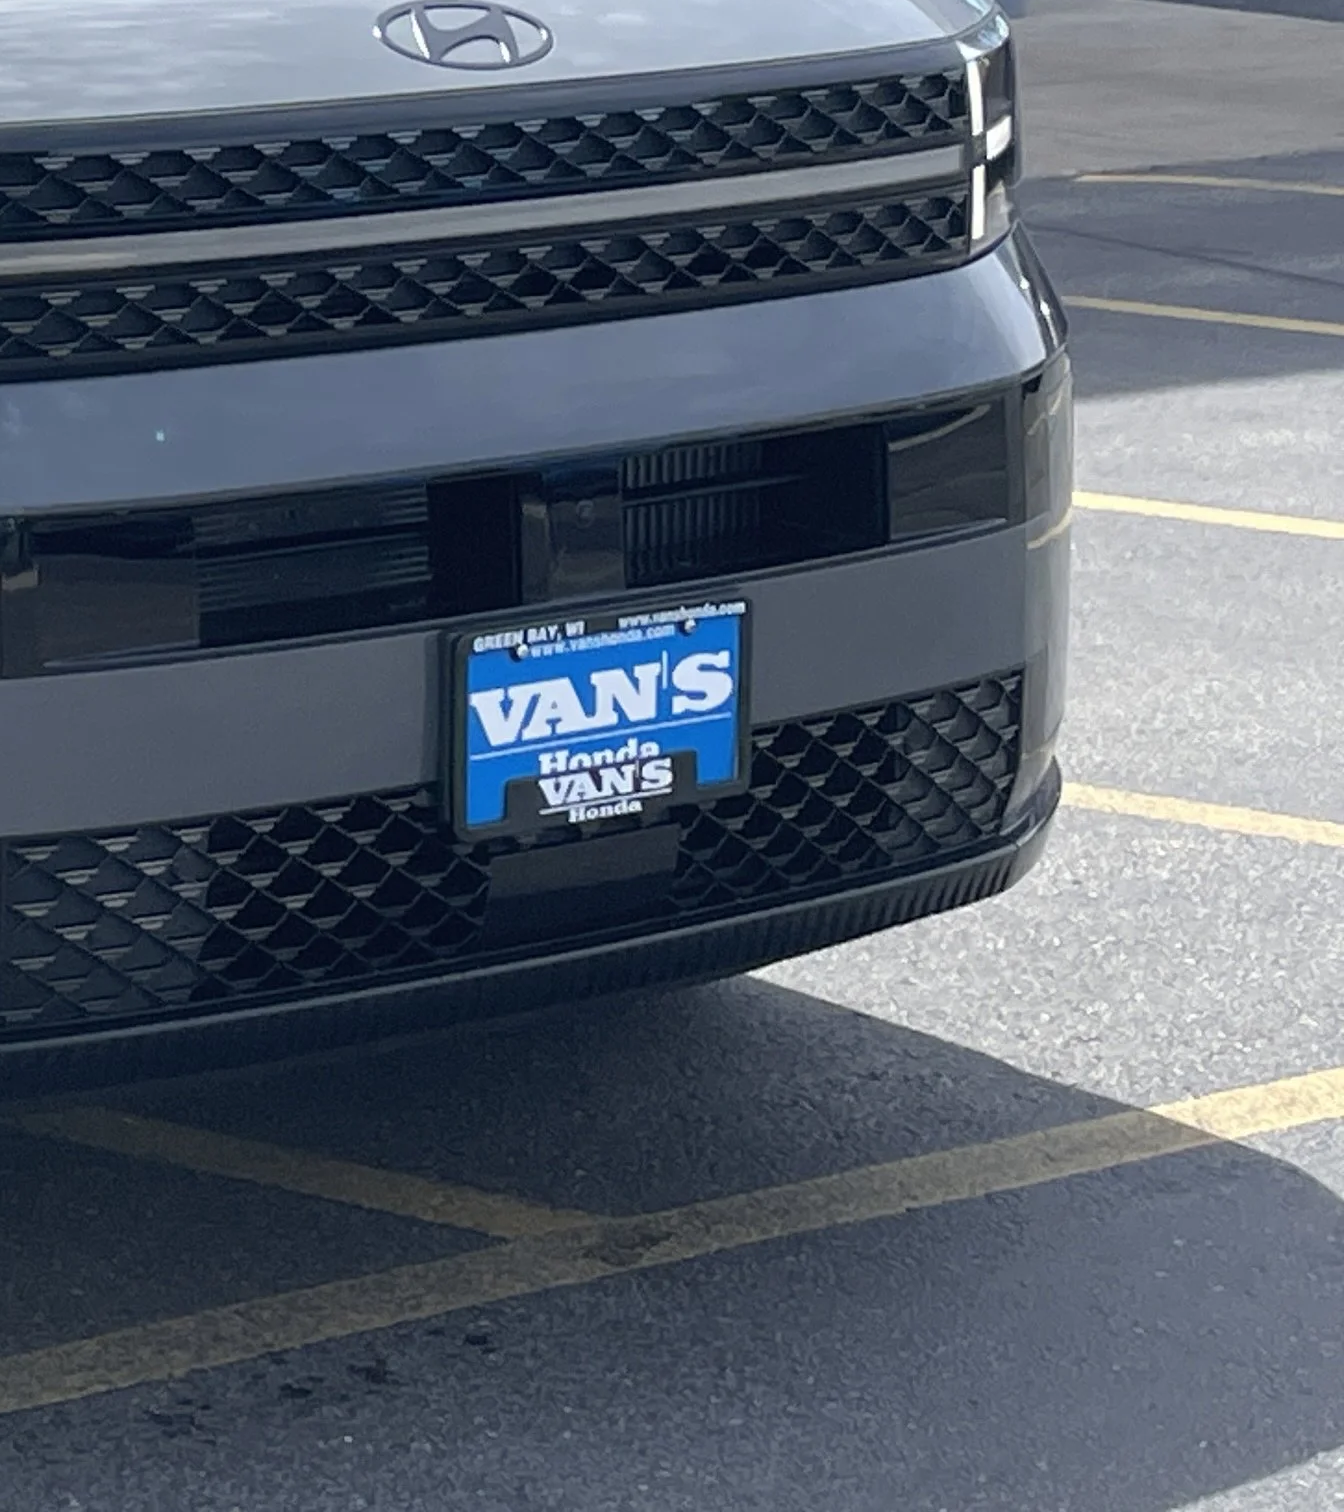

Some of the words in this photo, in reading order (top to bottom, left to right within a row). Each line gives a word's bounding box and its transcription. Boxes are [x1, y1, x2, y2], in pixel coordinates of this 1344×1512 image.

[473, 630, 524, 652] GREEN
[565, 620, 585, 637] WI
[470, 650, 733, 747] VAN'S
[538, 738, 660, 775] Honda
[538, 757, 673, 806] VAN'S
[568, 797, 643, 823] Honda
